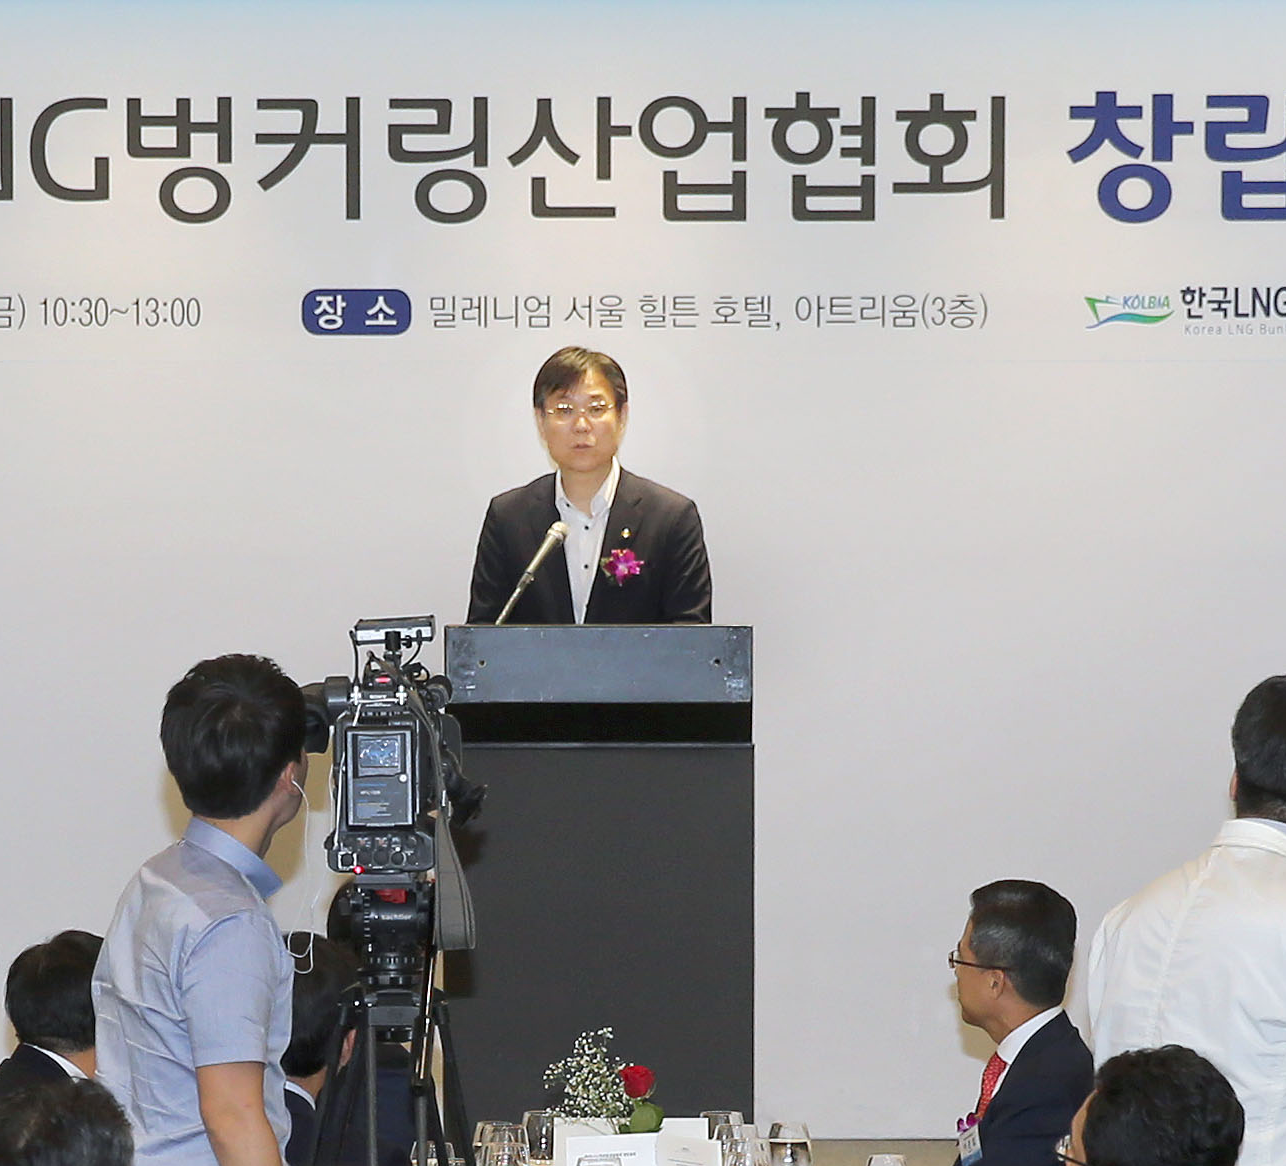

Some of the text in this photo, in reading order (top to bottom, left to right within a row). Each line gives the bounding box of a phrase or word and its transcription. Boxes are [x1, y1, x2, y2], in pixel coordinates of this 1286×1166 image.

[39, 296, 201, 328] 10:30~13:00
[429, 293, 989, 332] 밀레니엄 서울 힐튼 호텔, 아트리움(3층)
[1184, 323, 1223, 336] Korea
[1227, 323, 1254, 336] LNG
